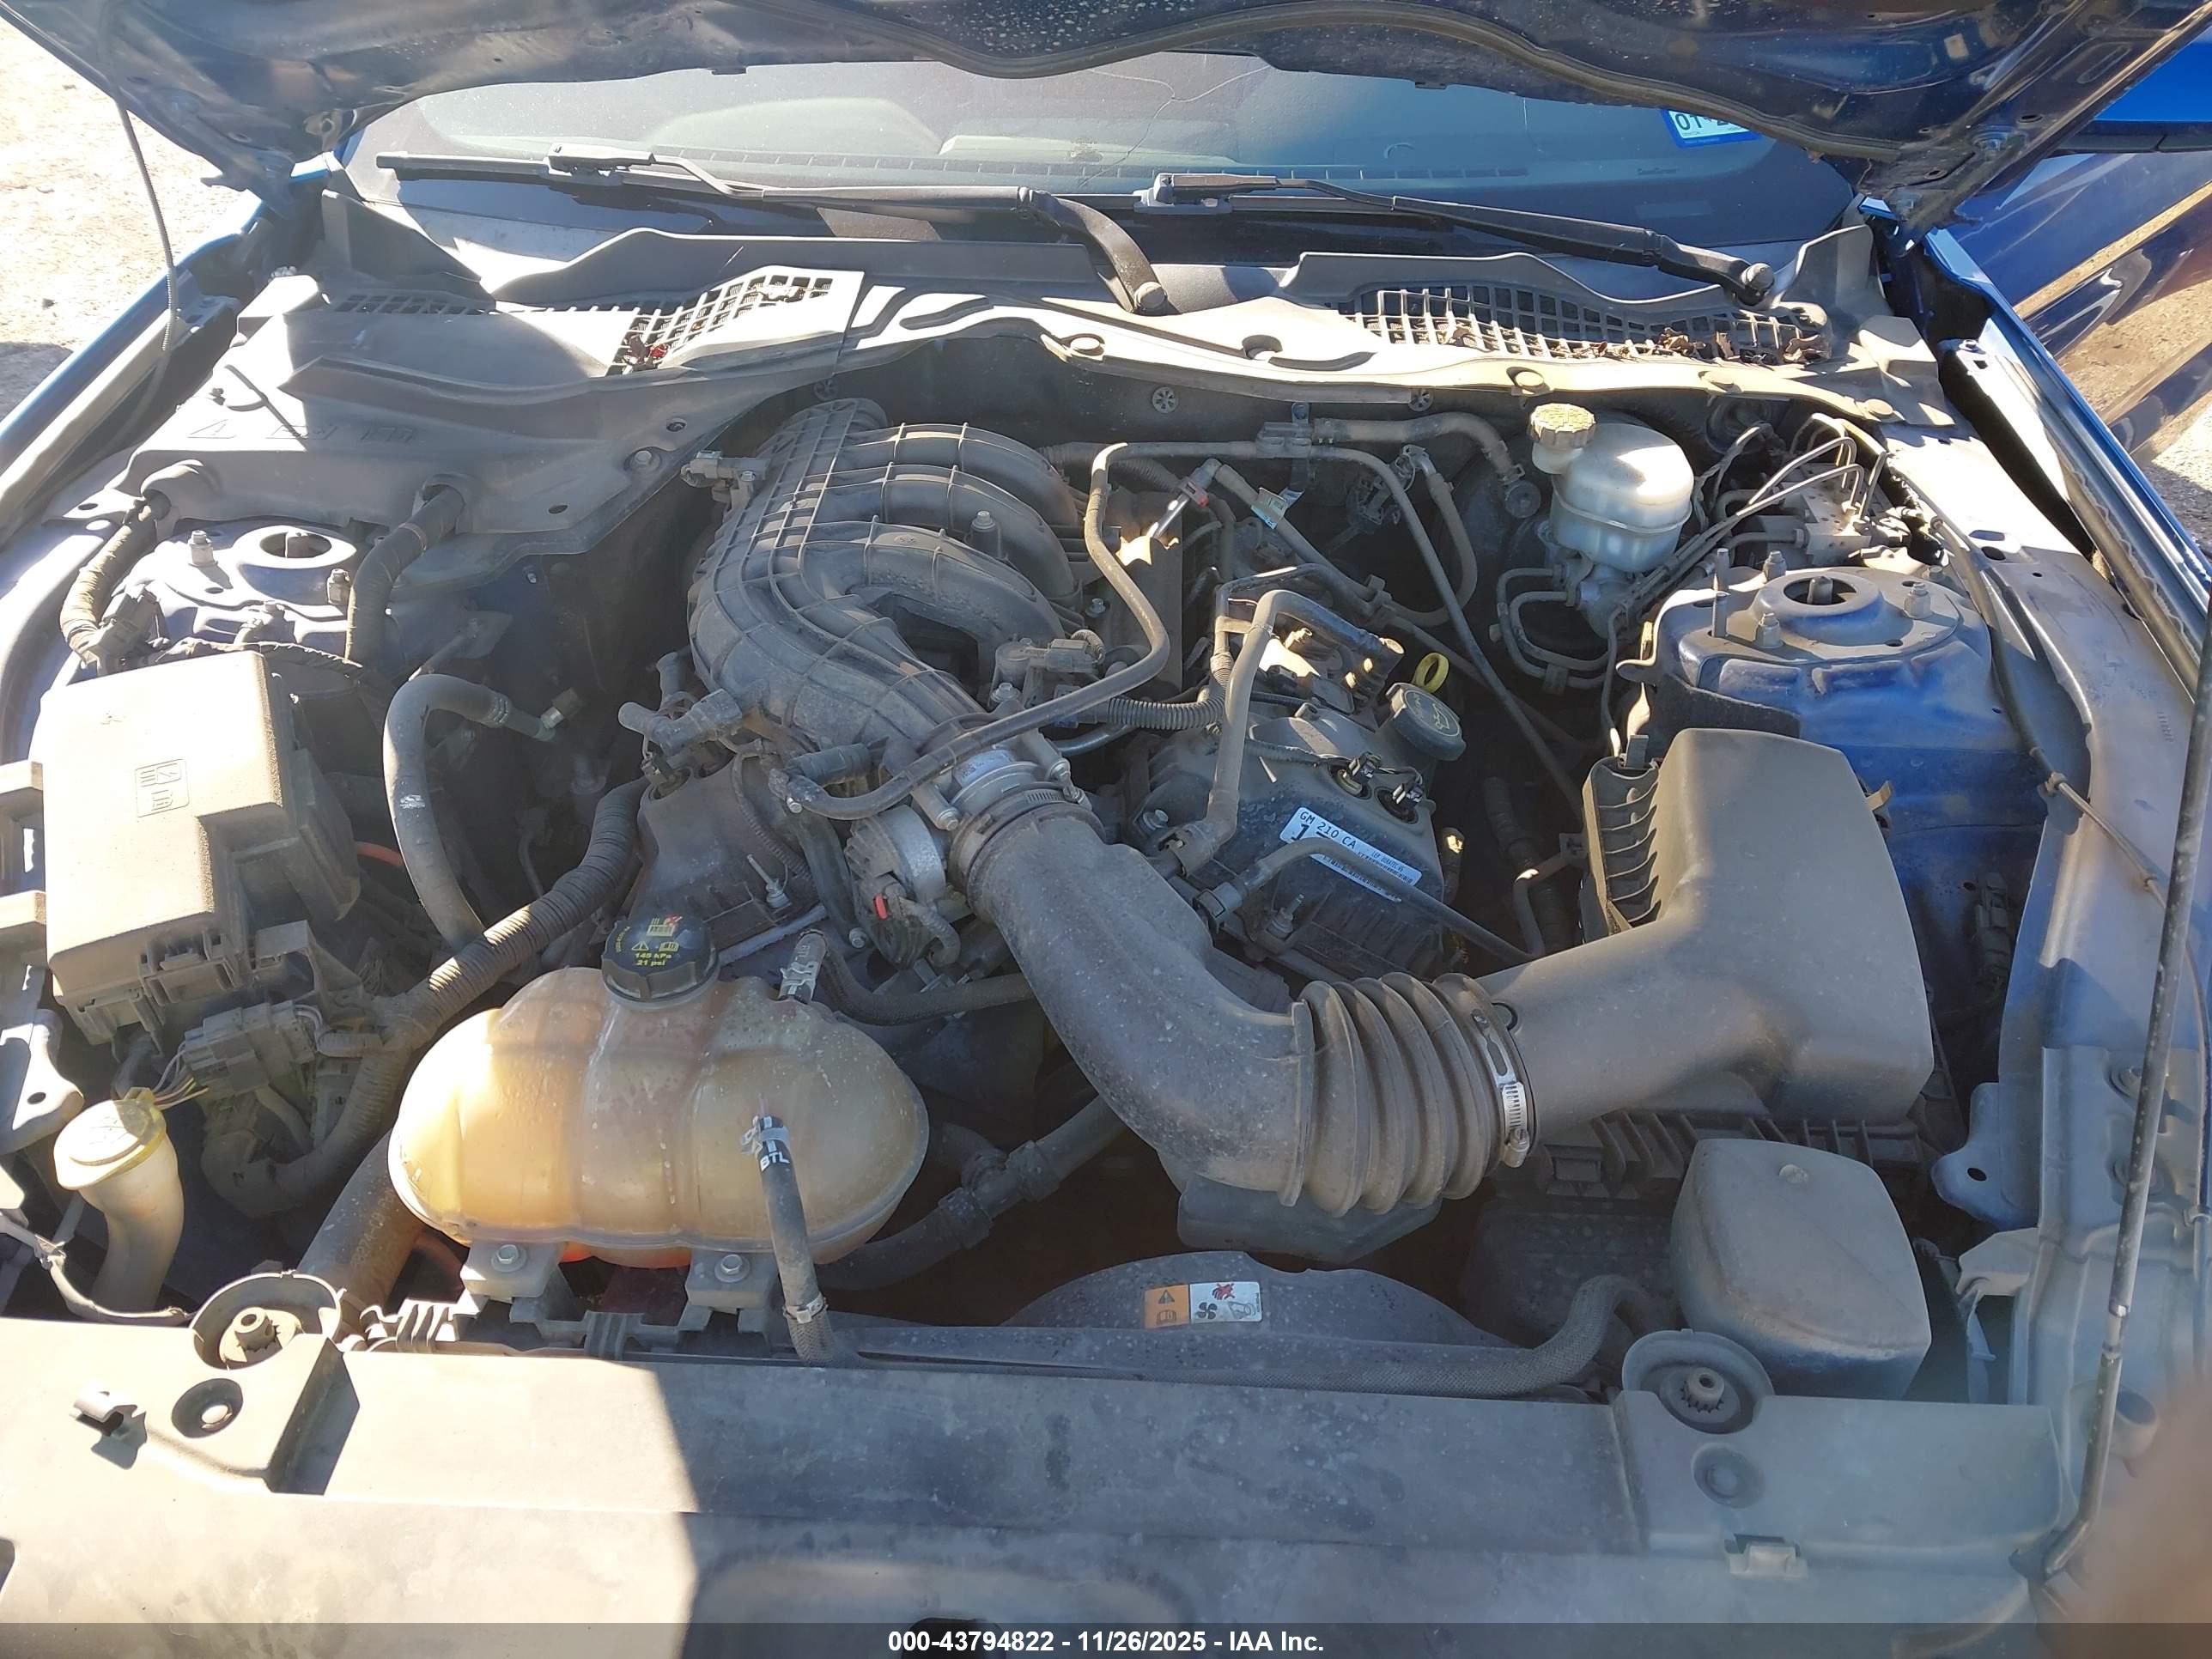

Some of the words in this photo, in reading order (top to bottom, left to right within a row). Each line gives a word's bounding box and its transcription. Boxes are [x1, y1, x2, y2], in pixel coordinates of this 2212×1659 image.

[1299, 811, 1316, 824] GM
[1316, 822, 1340, 839] 210
[1341, 836, 1357, 849] CA
